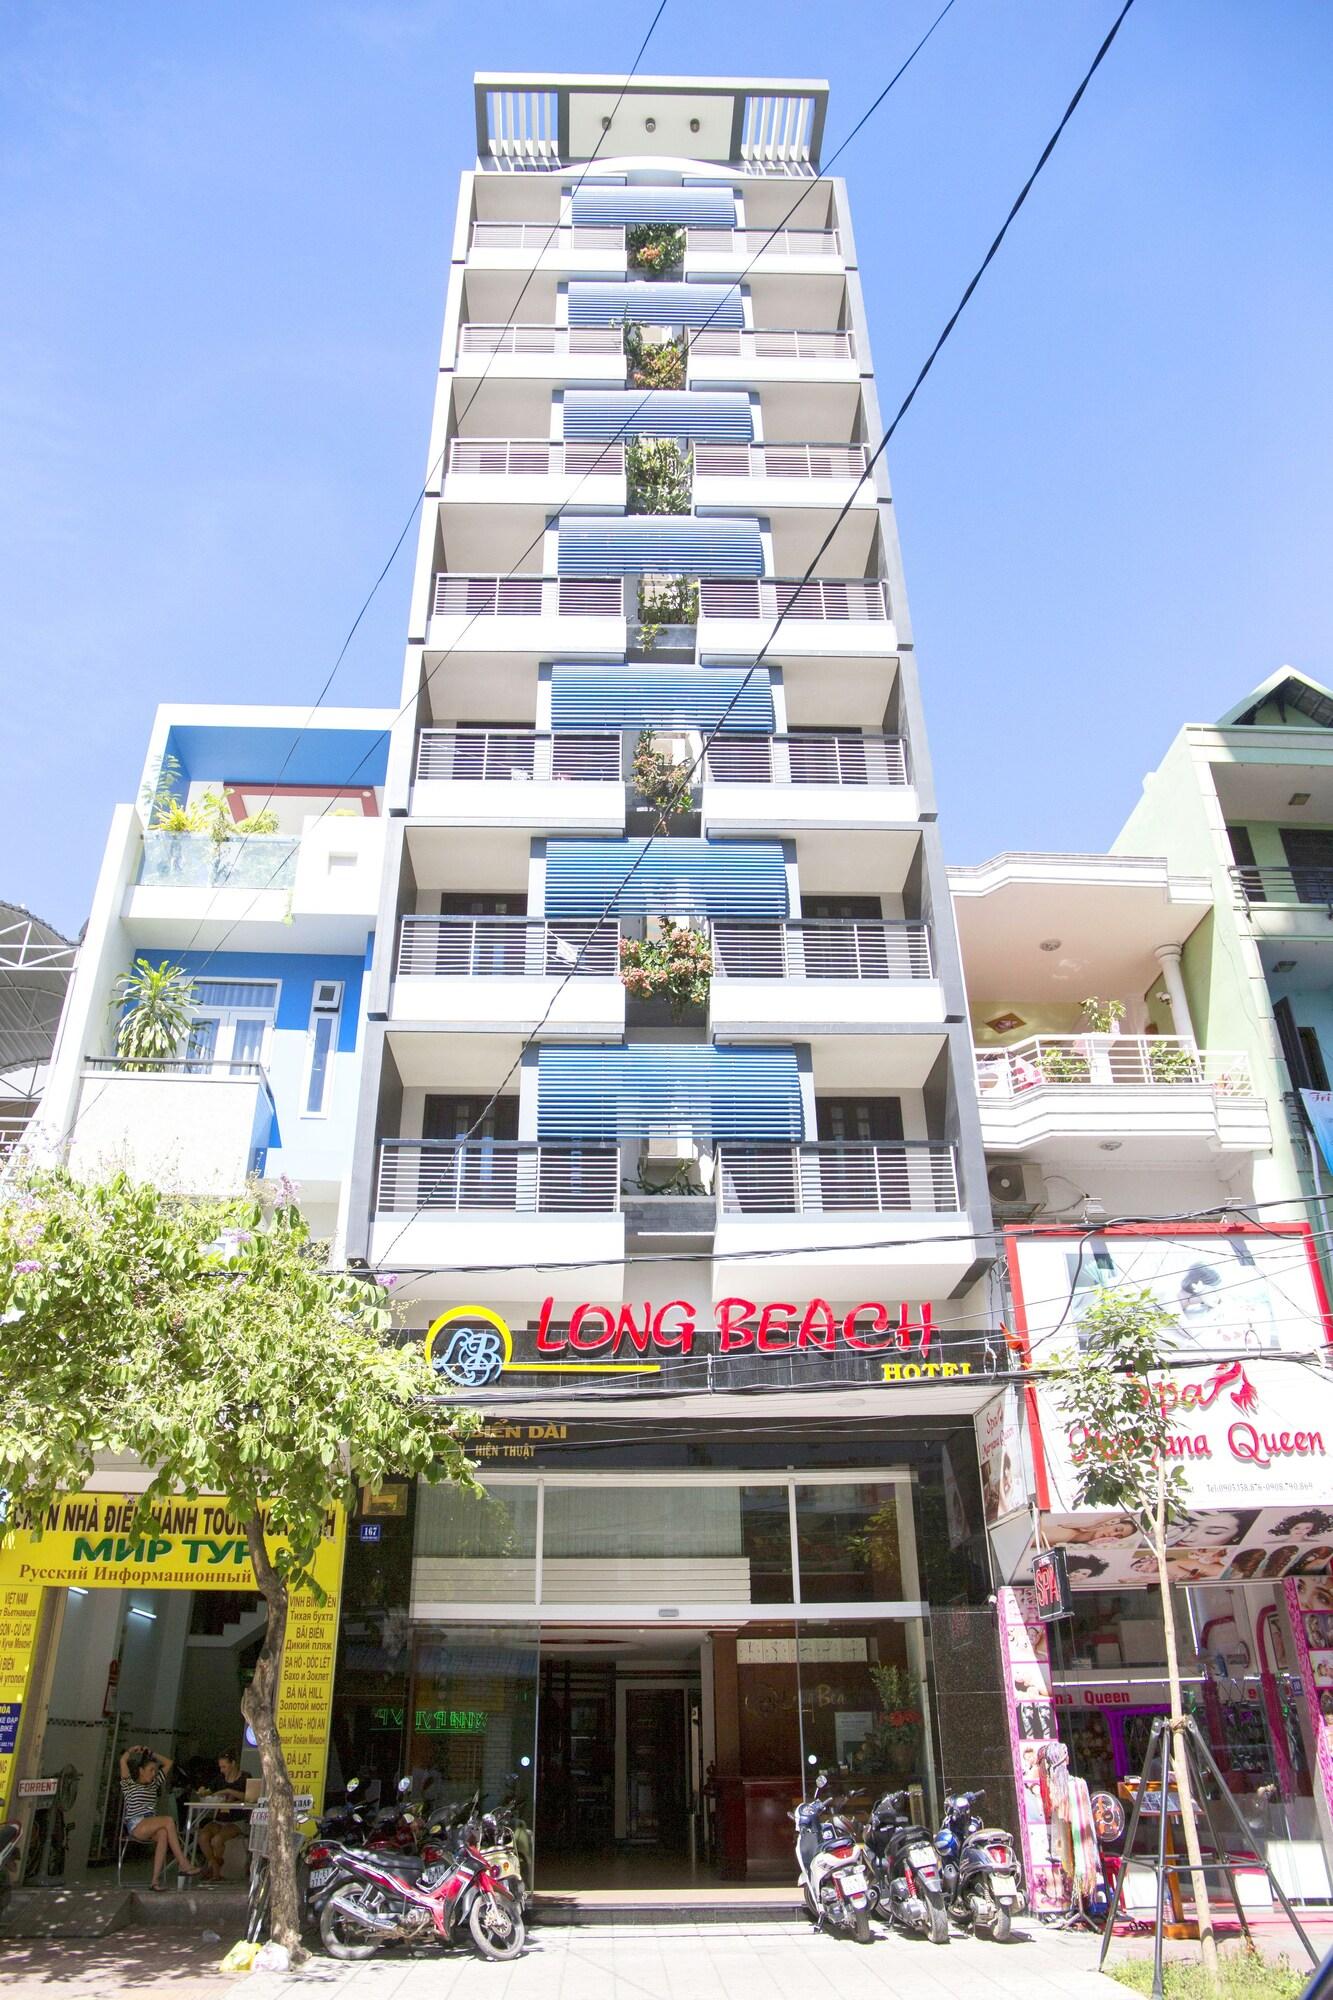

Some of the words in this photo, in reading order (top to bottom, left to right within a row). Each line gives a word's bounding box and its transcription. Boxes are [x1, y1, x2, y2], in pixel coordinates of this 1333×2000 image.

[537, 1296, 697, 1354] LONG
[713, 1297, 940, 1360] BEACH
[1126, 1371, 1204, 1419] pa
[528, 1423, 567, 1439] DÀI
[1227, 1422, 1326, 1465] Queen
[63, 1497, 99, 1532] NHÀ
[364, 1527, 378, 1536] 167
[72, 1537, 173, 1562] МИР
[19, 1564, 88, 1582] Русский
[94, 1566, 252, 1585] Информационный
[1035, 1564, 1060, 1607] SPA
[290, 1610, 311, 1621] Тихая
[313, 1610, 334, 1623] бухта
[286, 1640, 310, 1651] Дикий
[312, 1642, 333, 1651] пляж
[280, 1699, 310, 1711] Золотой
[311, 1702, 329, 1711] мост
[1084, 1689, 1131, 1705] Queen
[287, 1770, 320, 1779] алат
